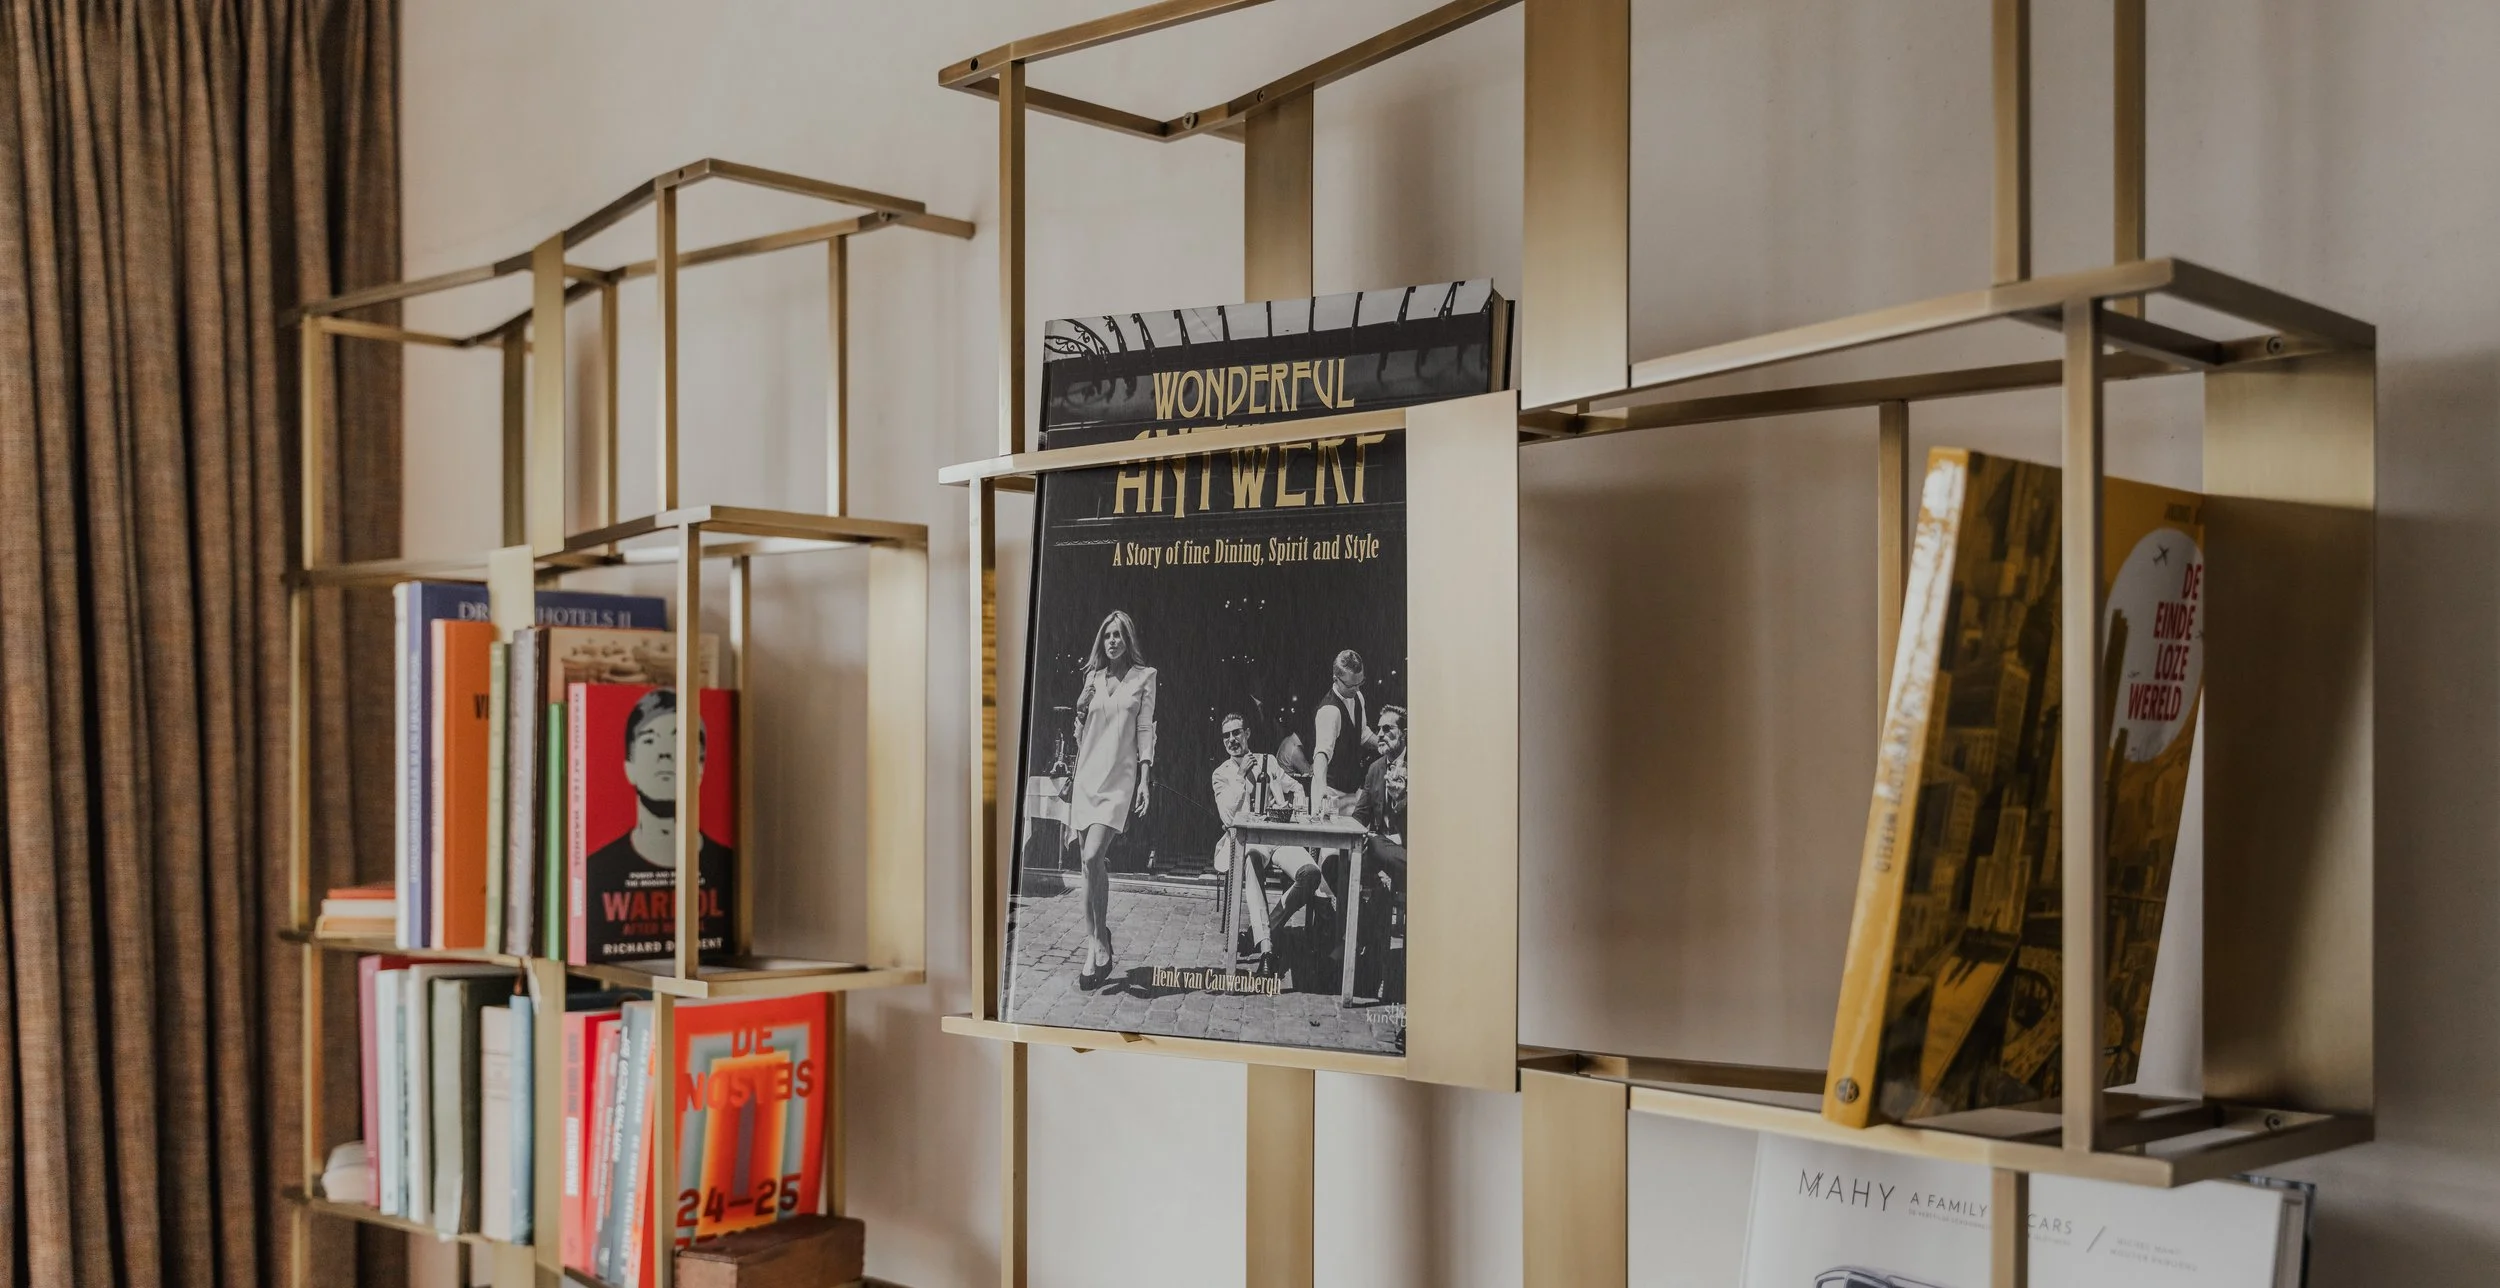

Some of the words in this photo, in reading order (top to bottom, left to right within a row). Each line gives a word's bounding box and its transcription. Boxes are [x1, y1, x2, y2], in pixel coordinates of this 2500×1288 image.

[1152, 358, 1355, 421] WONDERFUL
[1112, 542, 1122, 567] A
[1126, 540, 1162, 569] Story
[1166, 540, 1181, 565] of
[1182, 539, 1210, 566] fine
[1214, 538, 1264, 567] Dining,
[1269, 535, 1309, 569] Spirit
[1313, 534, 1341, 562] and
[1345, 533, 1380, 563] Style
[2181, 563, 2202, 600] DE
[2153, 601, 2196, 641] EINDE
[2154, 643, 2190, 682] LOZE
[2127, 683, 2183, 723] WERELD
[602, 941, 662, 955] RICHARD
[665, 937, 723, 952] DENT
[1152, 965, 1181, 988] Henk
[1183, 971, 1202, 989] van
[1204, 968, 1281, 998] Cauwenbergh
[731, 1025, 774, 1058] DE
[1798, 1167, 1895, 1212] MAHY
[1910, 1191, 1920, 1206] A
[1927, 1194, 1989, 1218] FAMILY
[2027, 1213, 2073, 1235] CARS
